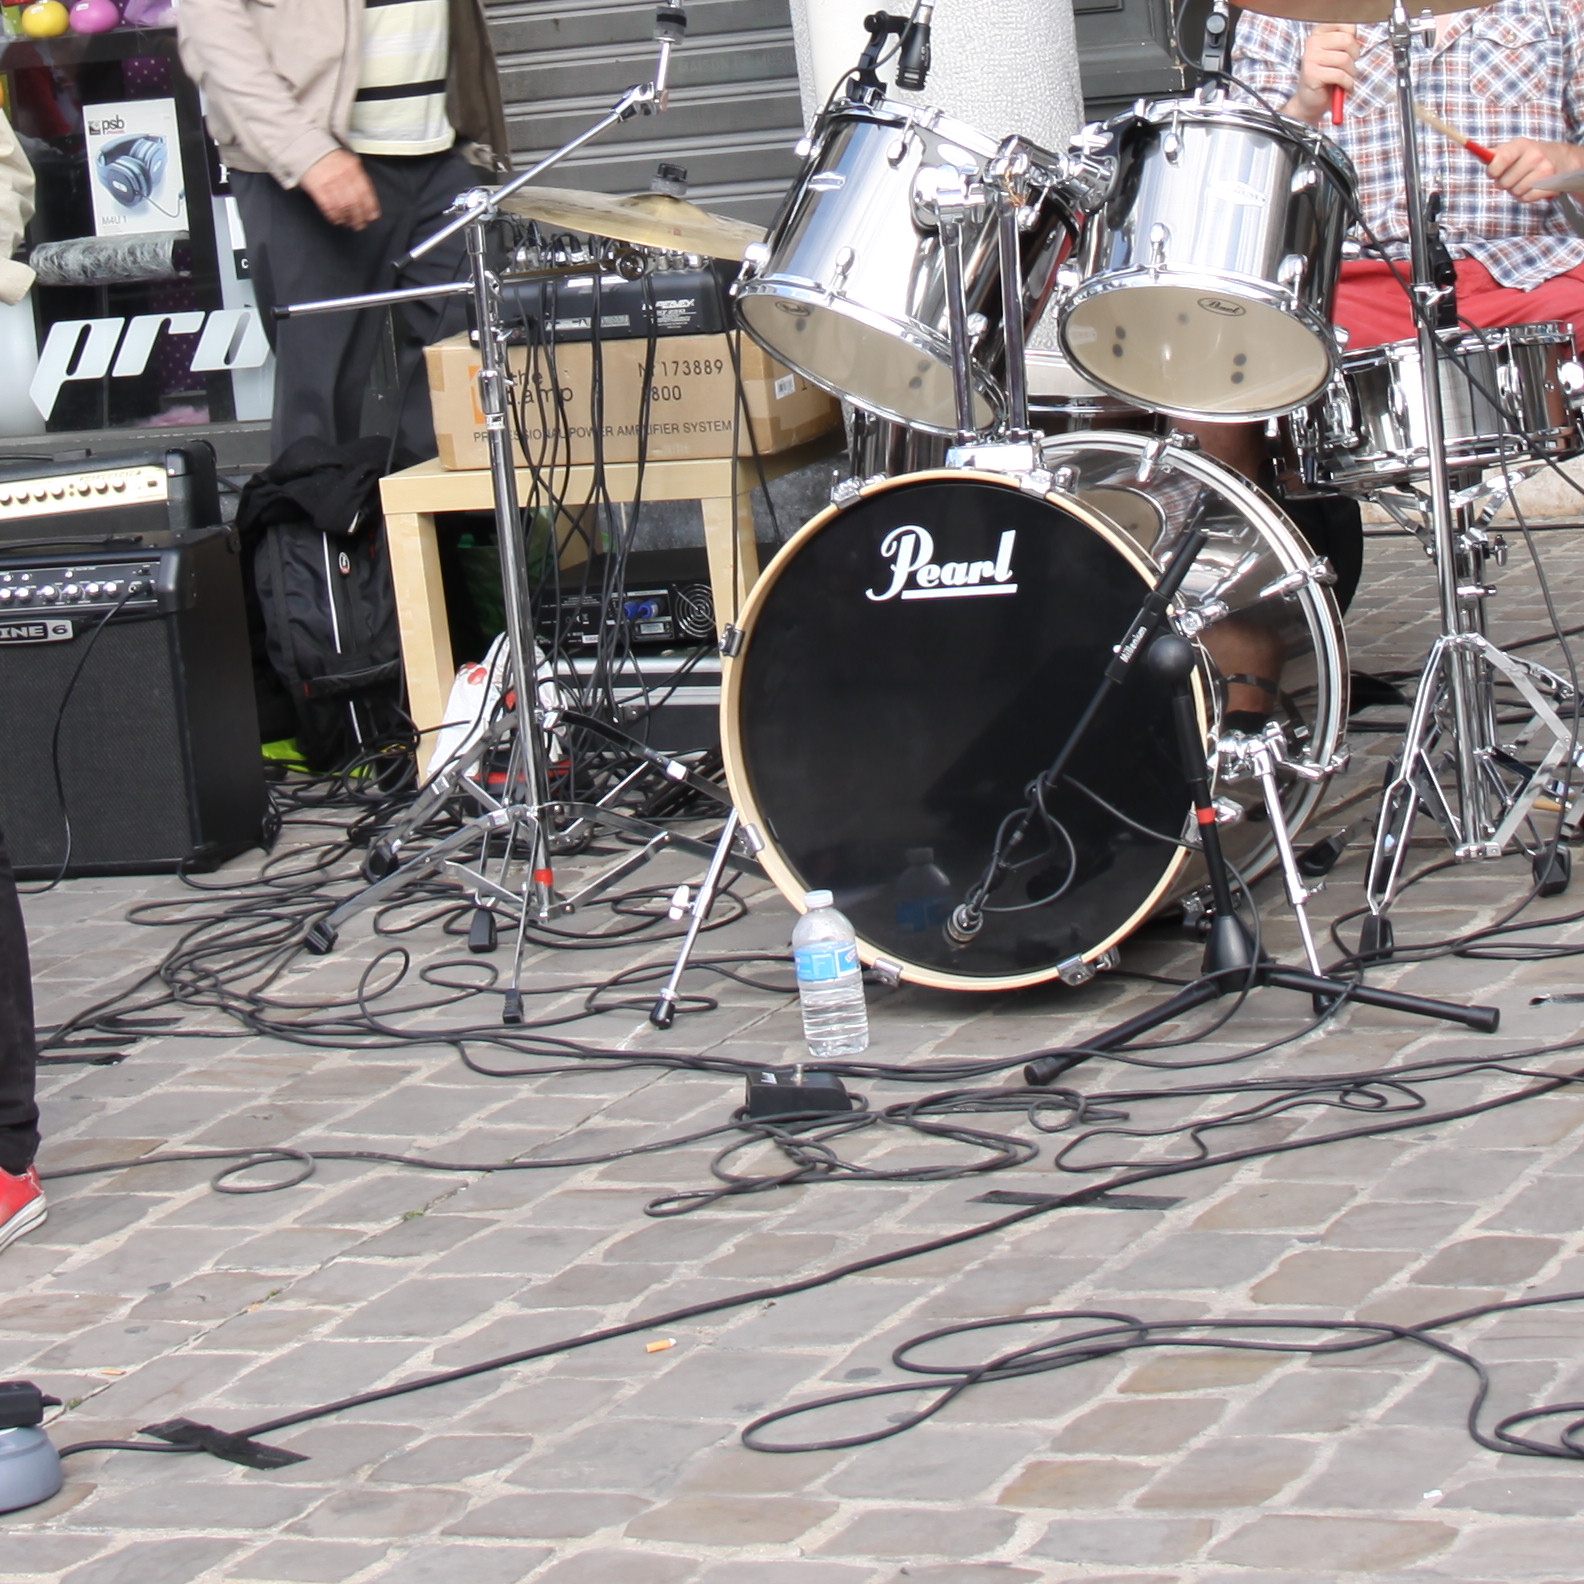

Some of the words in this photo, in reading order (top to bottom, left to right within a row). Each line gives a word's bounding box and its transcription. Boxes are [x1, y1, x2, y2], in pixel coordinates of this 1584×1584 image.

[101, 114, 125, 135] psb
[29, 308, 274, 422] pro
[661, 359, 725, 377] 173889
[683, 419, 733, 435] SYSTEM
[865, 524, 1016, 601] Pearl
[52, 624, 67, 637] 6
